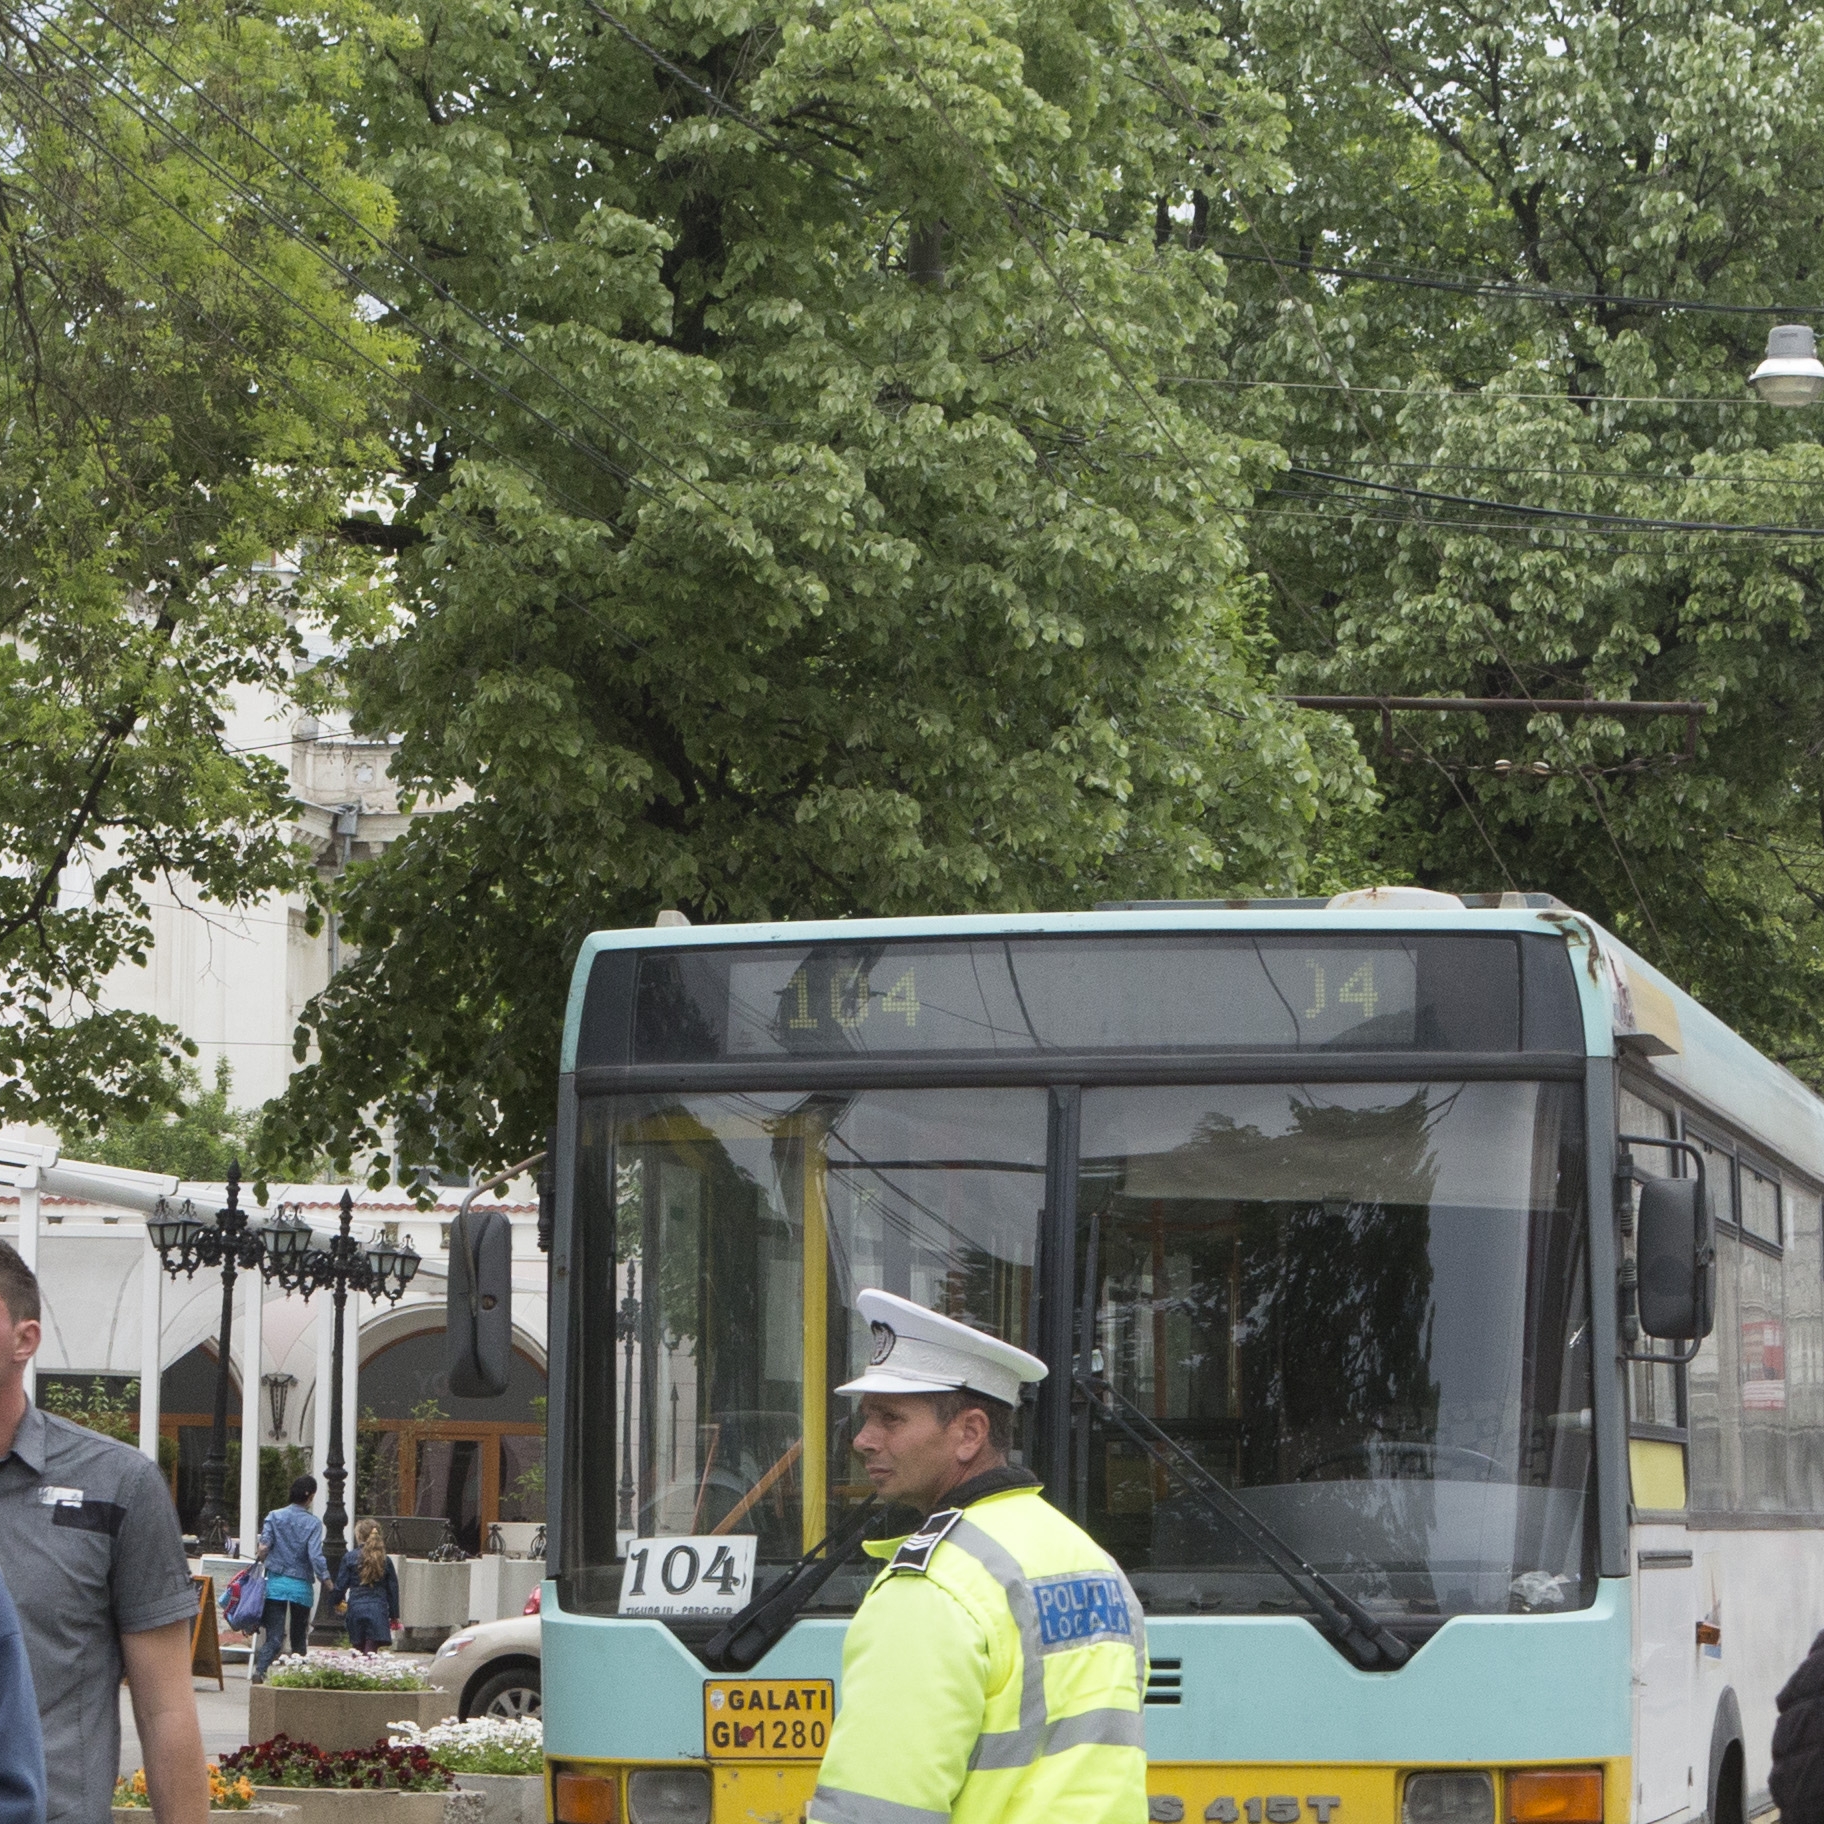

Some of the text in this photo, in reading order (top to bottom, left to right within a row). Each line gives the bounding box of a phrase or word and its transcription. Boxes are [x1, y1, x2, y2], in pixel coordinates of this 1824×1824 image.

[788, 967, 920, 1029] 104
[628, 1545, 741, 1597] 104
[1039, 1581, 1125, 1616] POLITIA
[1046, 1611, 1128, 1641] LOCALA
[728, 1689, 827, 1711] GALATI
[755, 1720, 826, 1749] 1280
